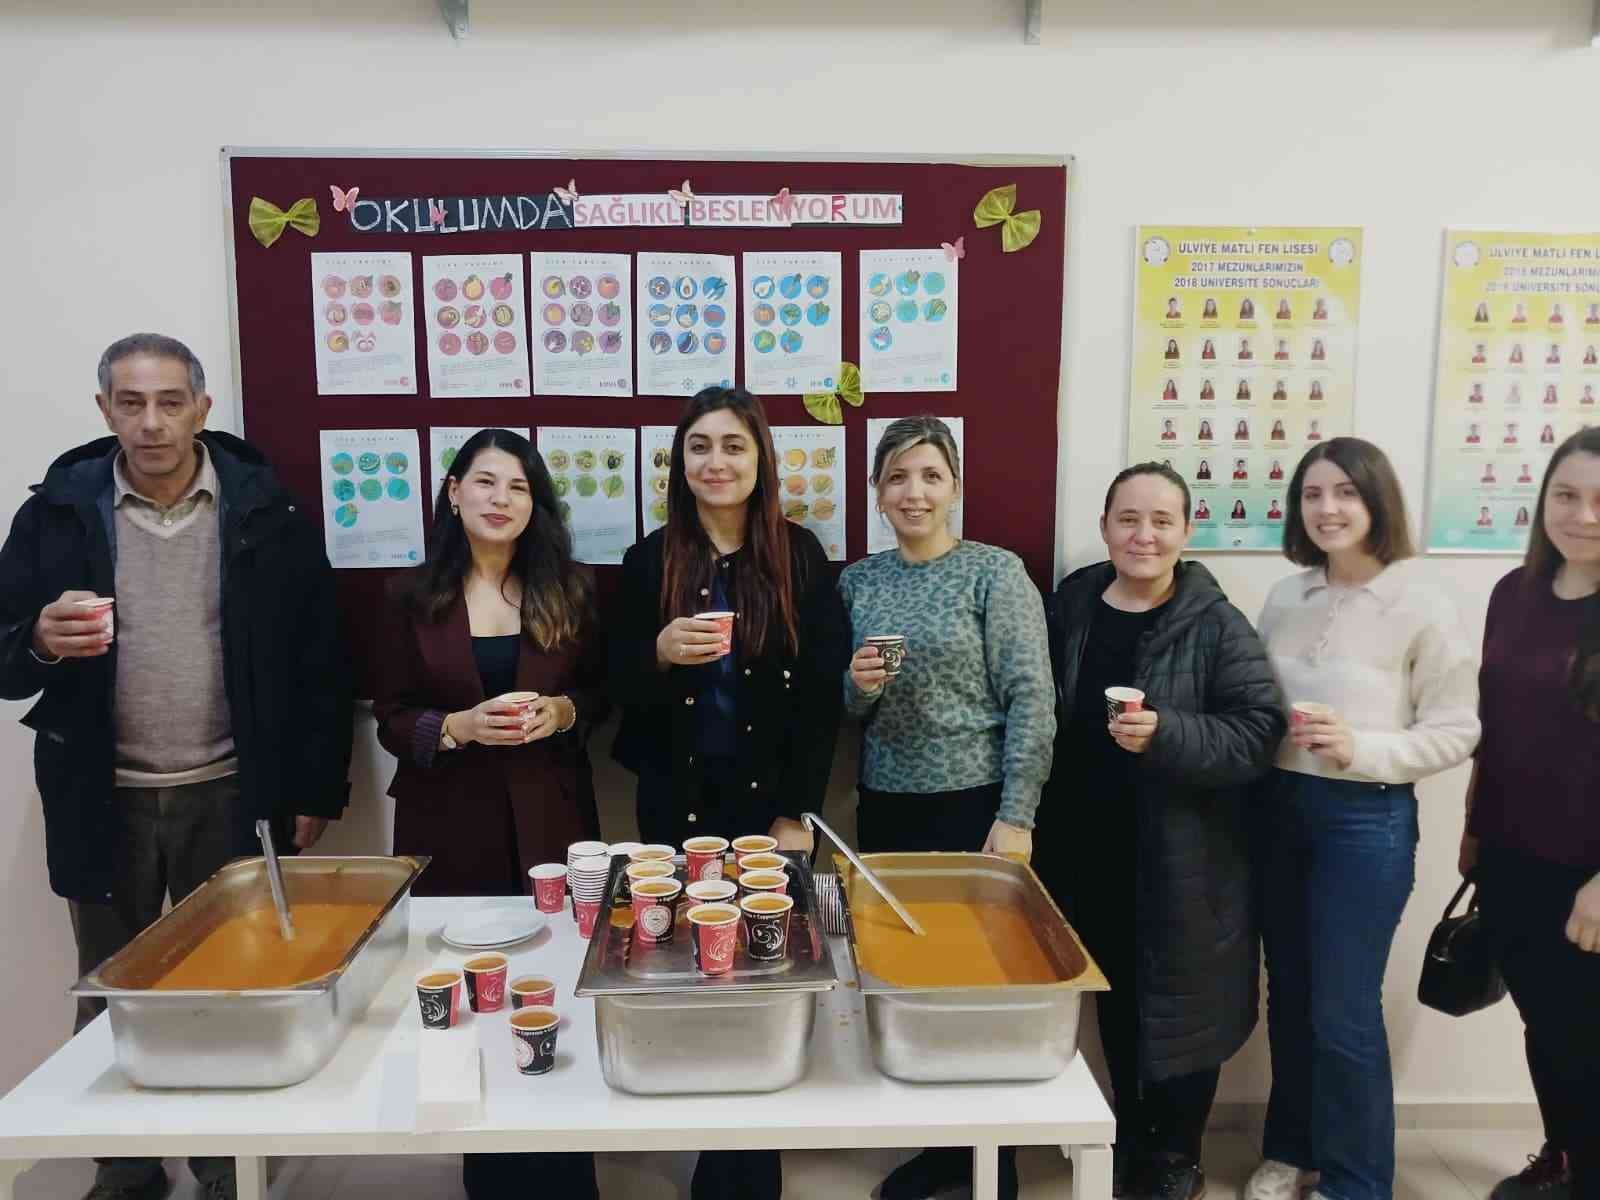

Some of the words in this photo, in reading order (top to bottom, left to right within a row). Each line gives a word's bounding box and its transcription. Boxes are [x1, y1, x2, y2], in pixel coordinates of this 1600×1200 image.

[350, 193, 573, 234] OKULUMDA
[1258, 243, 1279, 254] FEN
[1191, 262, 1214, 272] 2017
